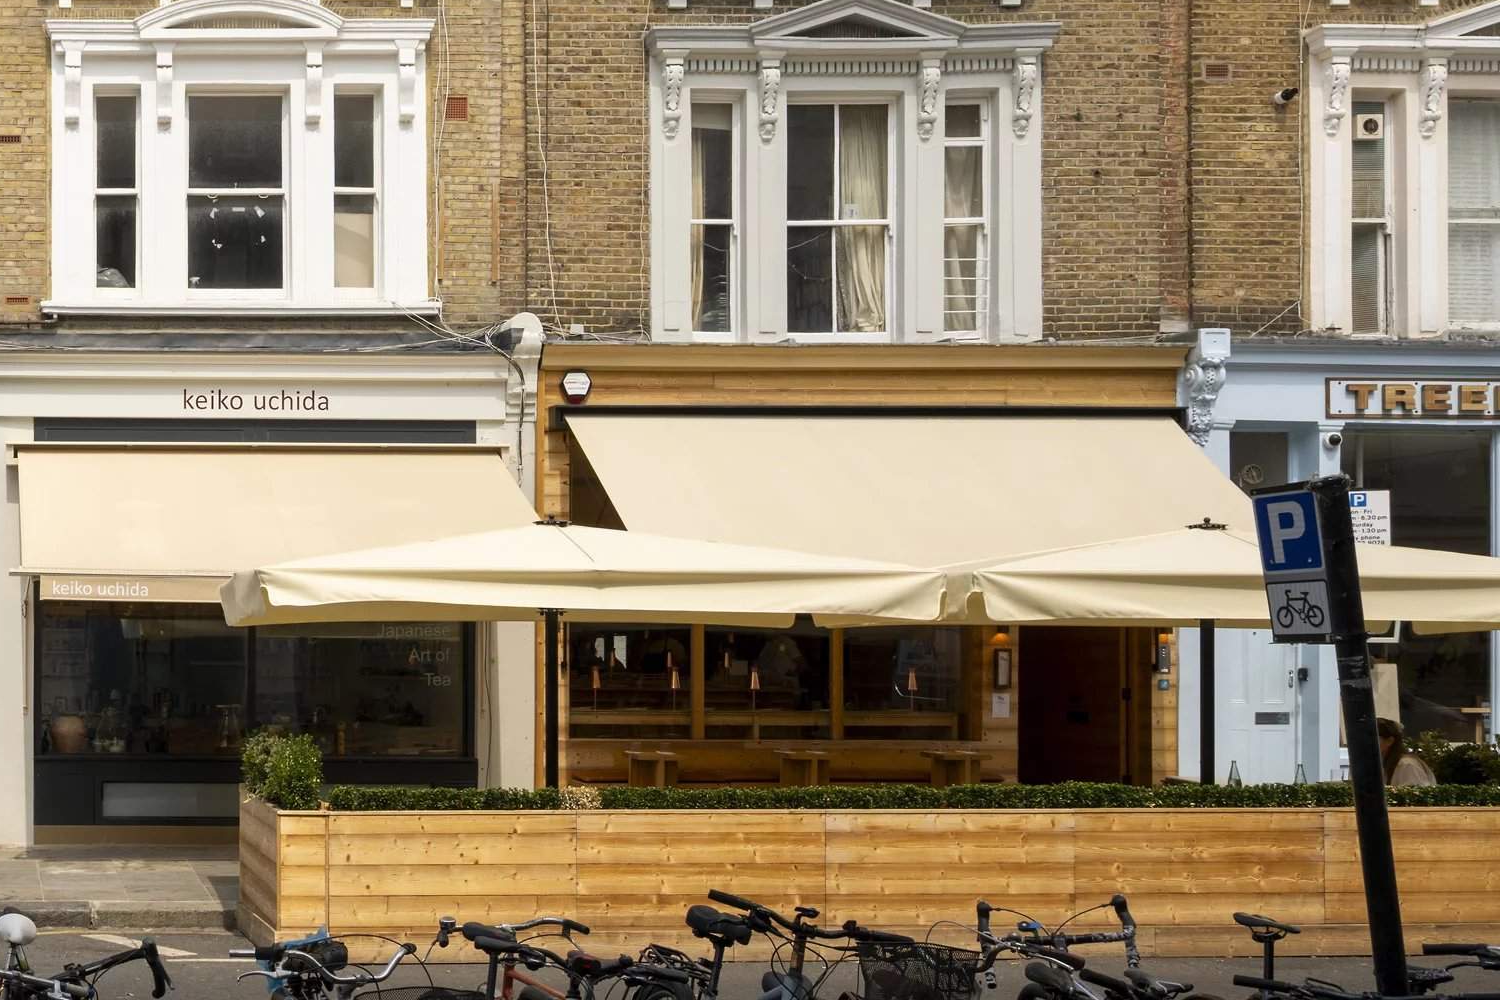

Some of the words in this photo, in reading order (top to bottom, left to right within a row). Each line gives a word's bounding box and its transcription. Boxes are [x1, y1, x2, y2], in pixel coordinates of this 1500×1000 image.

[183, 388, 244, 410] keiko
[254, 389, 329, 411] uchida
[1354, 495, 1365, 506] P
[1267, 501, 1306, 564] P
[52, 580, 92, 596] keiko
[97, 582, 149, 597] uchida
[378, 623, 450, 641] Japanese
[408, 647, 431, 663] Art
[435, 647, 450, 663] of
[423, 672, 452, 687] Tea
